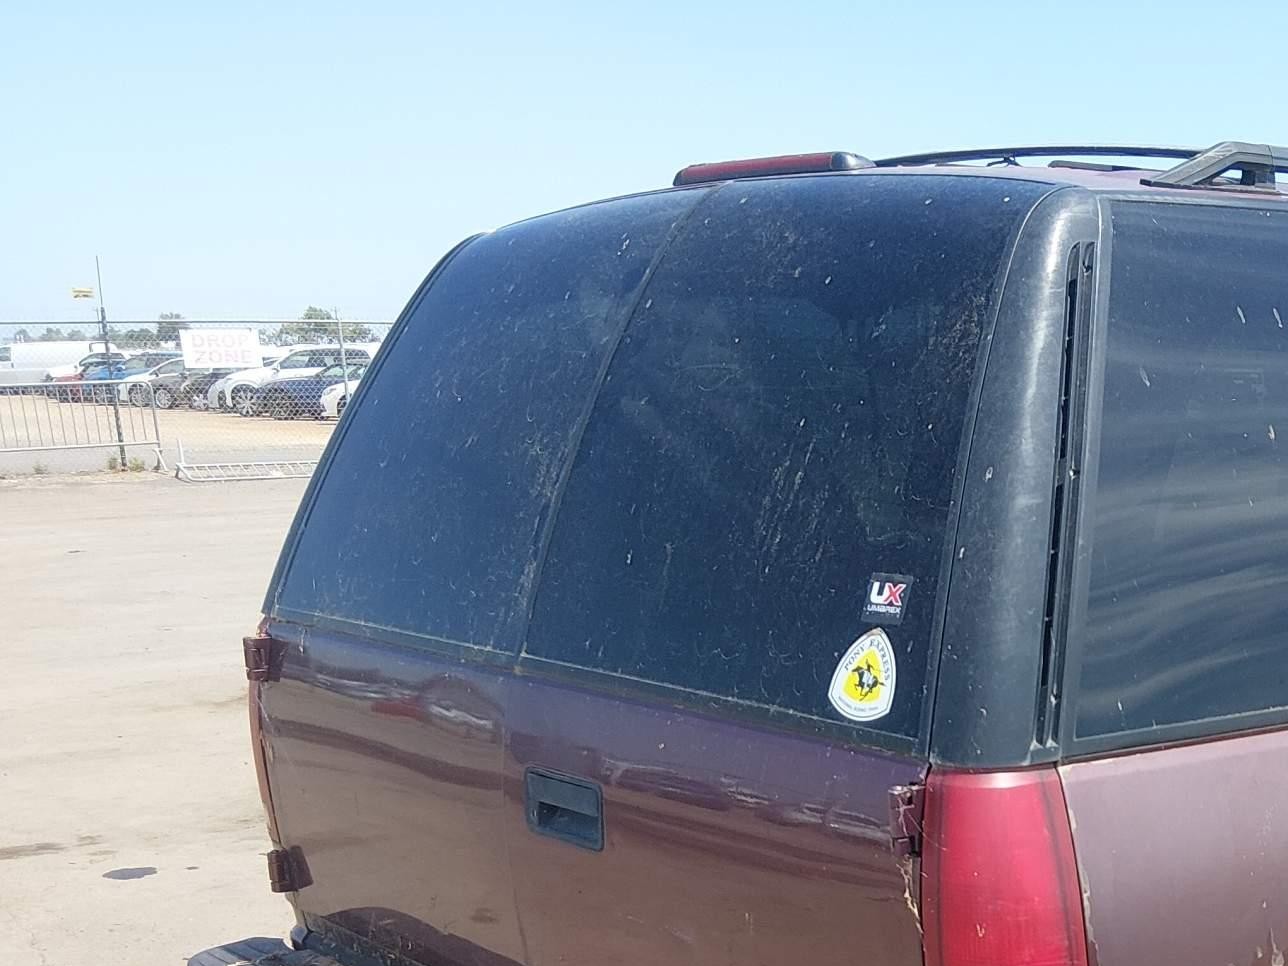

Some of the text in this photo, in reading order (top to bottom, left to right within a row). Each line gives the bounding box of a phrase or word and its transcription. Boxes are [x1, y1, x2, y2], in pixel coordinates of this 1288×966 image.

[191, 333, 248, 348] DROP
[193, 349, 253, 364] ZONE
[869, 581, 907, 606] UX
[844, 638, 891, 681] PONY EXPRESS
